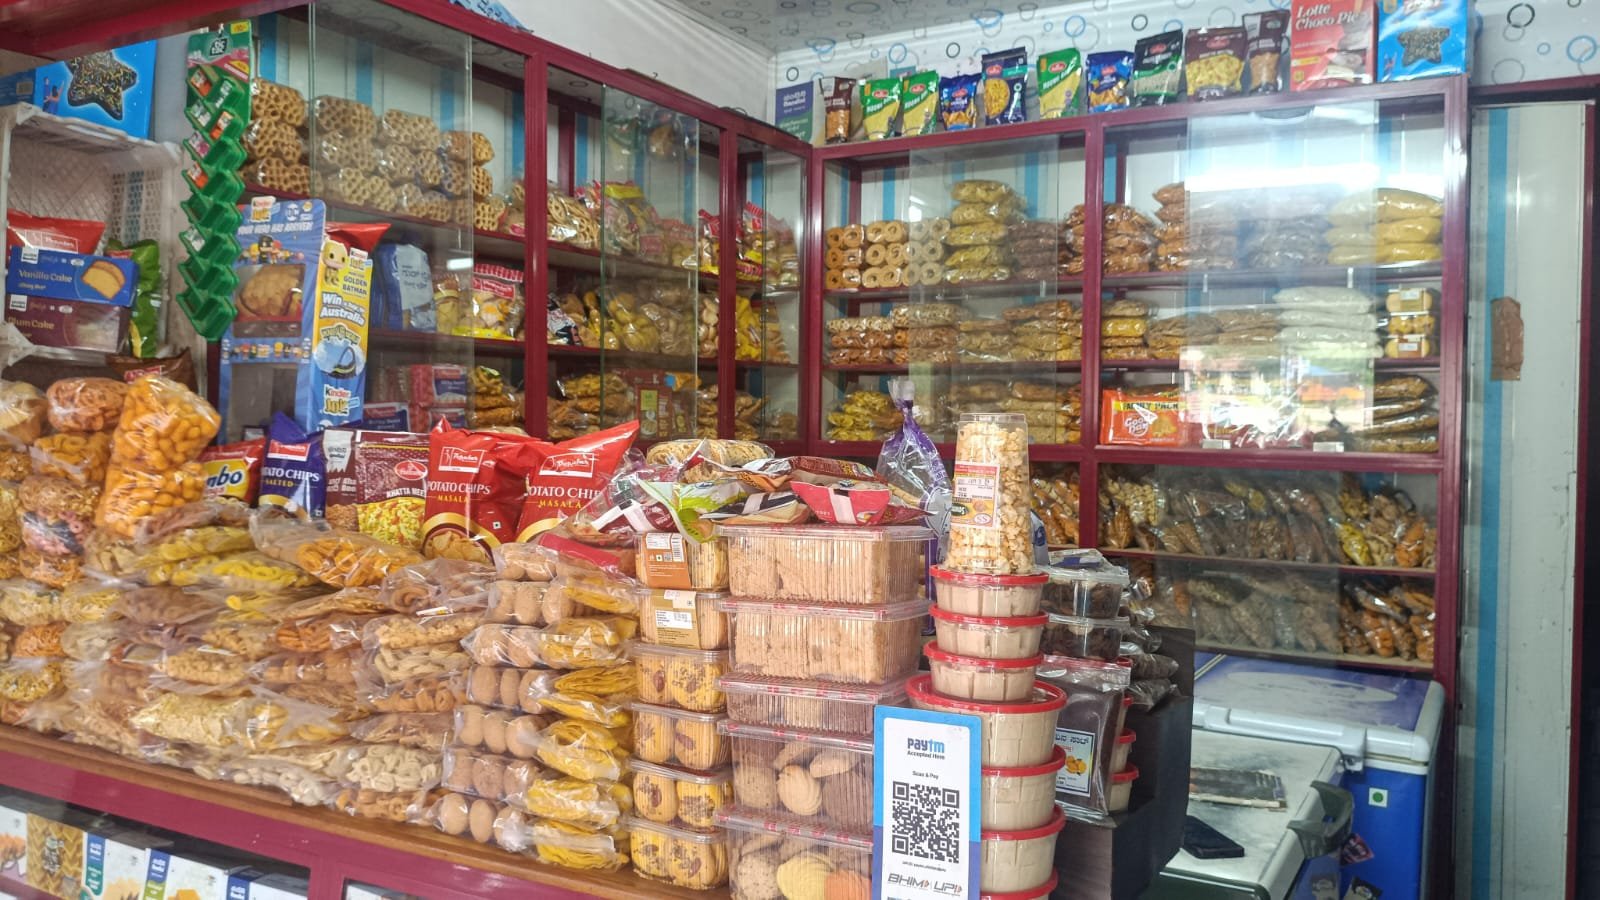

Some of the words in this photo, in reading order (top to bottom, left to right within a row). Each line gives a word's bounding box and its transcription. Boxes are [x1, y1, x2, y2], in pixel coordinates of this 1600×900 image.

[1297, 4, 1331, 18] Lotte
[1296, 16, 1335, 31] Choco
[19, 269, 49, 280] Vanilla
[50, 273, 73, 283] Cake
[344, 276, 367, 286] GOLDEN
[342, 284, 367, 294] BATMAN
[323, 293, 342, 305] Win
[320, 306, 365, 326] Australia
[32, 319, 55, 330] Cake
[285, 468, 320, 482] CHIPS
[386, 488, 411, 498] KHATTA
[458, 482, 491, 495] CHIPS
[524, 486, 565, 497] OTATO
[437, 495, 468, 503] MASALA
[538, 500, 582, 509] MASALA
[907, 737, 945, 753] paytm
[907, 750, 932, 759] Accepted
[888, 873, 925, 888] BHIM
[934, 881, 959, 893] UPI
